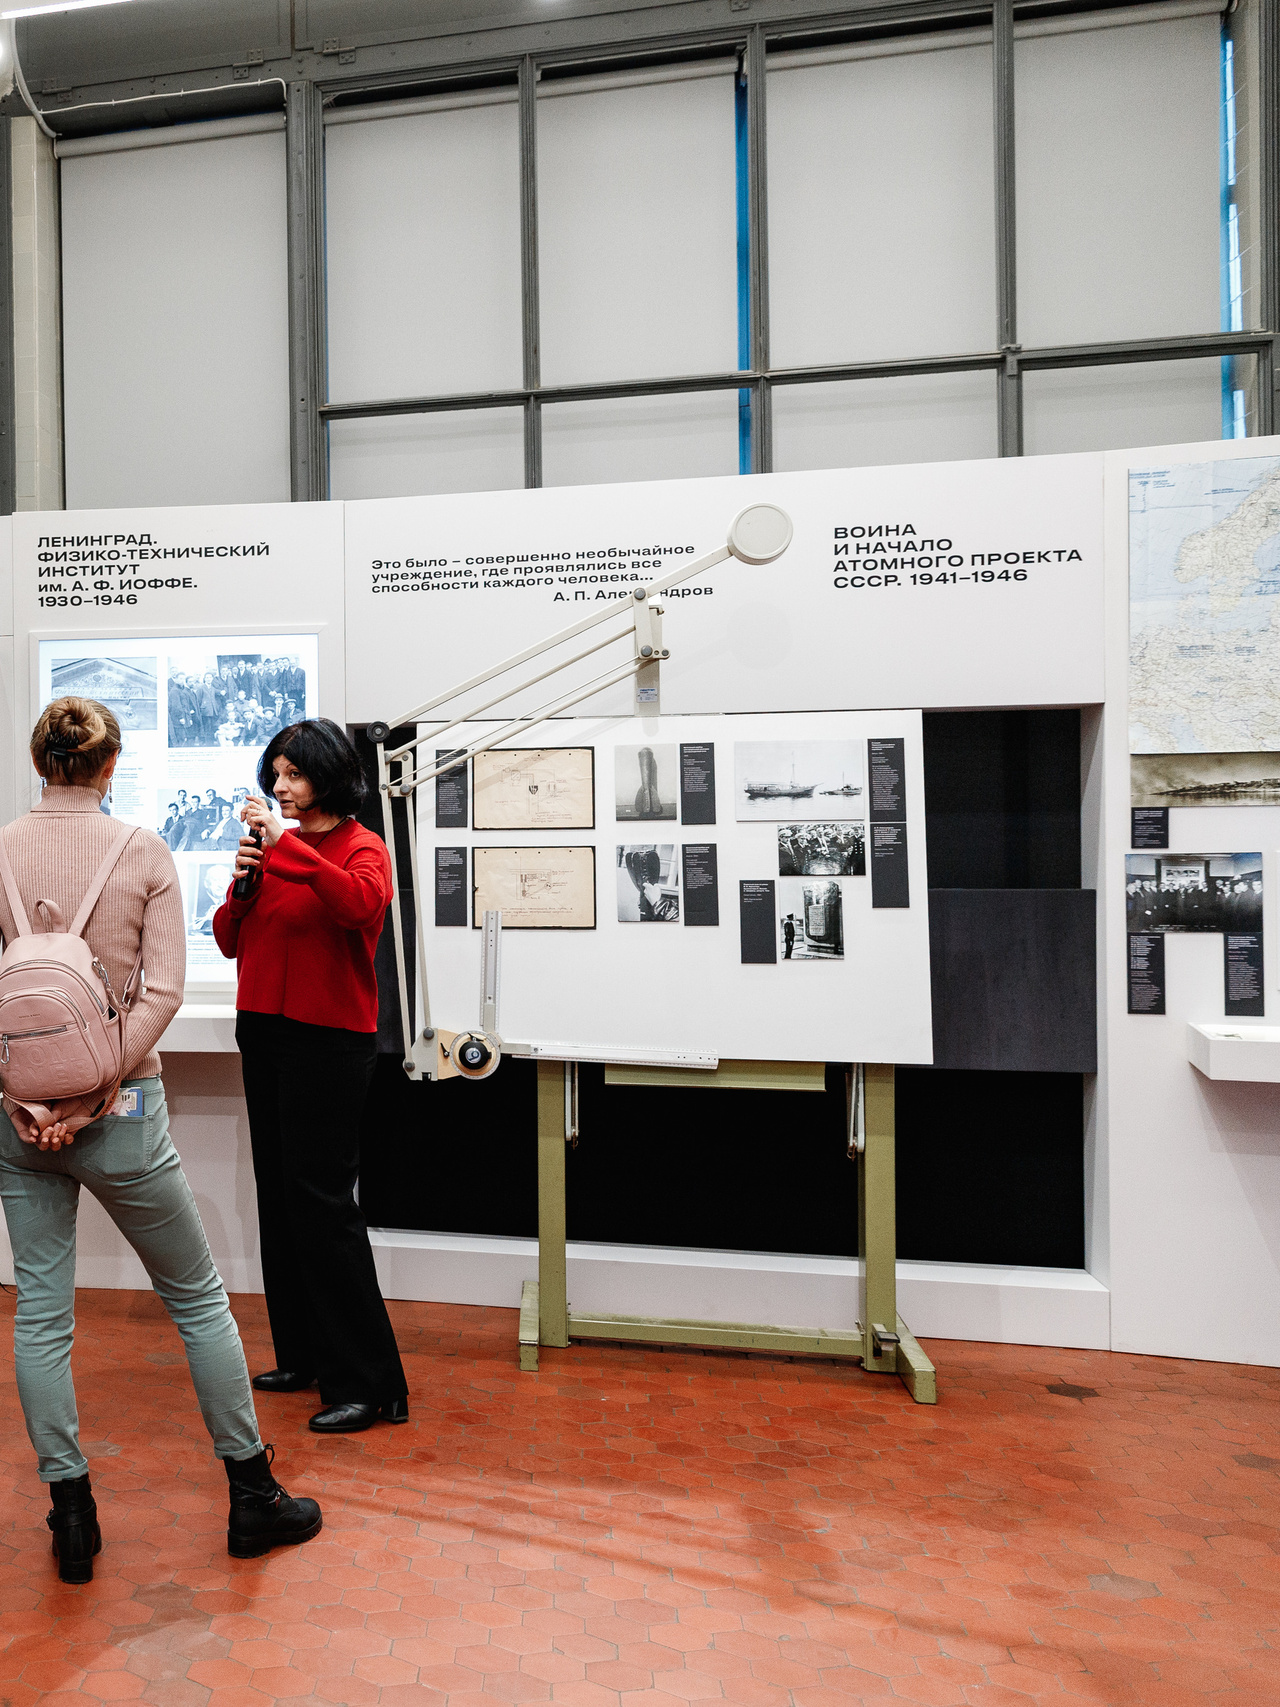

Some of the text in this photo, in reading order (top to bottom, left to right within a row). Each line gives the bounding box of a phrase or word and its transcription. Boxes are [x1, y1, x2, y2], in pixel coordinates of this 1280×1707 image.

[38, 534, 157, 547] ЛЕНИНГРАД.
[834, 539, 952, 555] И НАЧАЛО
[38, 542, 269, 562] ФИЗИКО-ТЕХНИЧЕСКИЙ
[372, 560, 401, 569] Это
[406, 558, 447, 568] было
[466, 553, 570, 565] совершенно
[576, 545, 694, 559] необычайное
[834, 550, 1082, 572] АТОМНОГО ПРОЕКТА
[39, 564, 140, 577] ИНСТИТУТ
[372, 560, 661, 583] учреждение, где проявлялись все
[39, 578, 197, 592] им. А. Ф. ИОФФЕ.
[372, 574, 653, 593] способности каждого человека...
[834, 575, 901, 588] СССР.
[554, 588, 713, 601] А. П. Алендров
